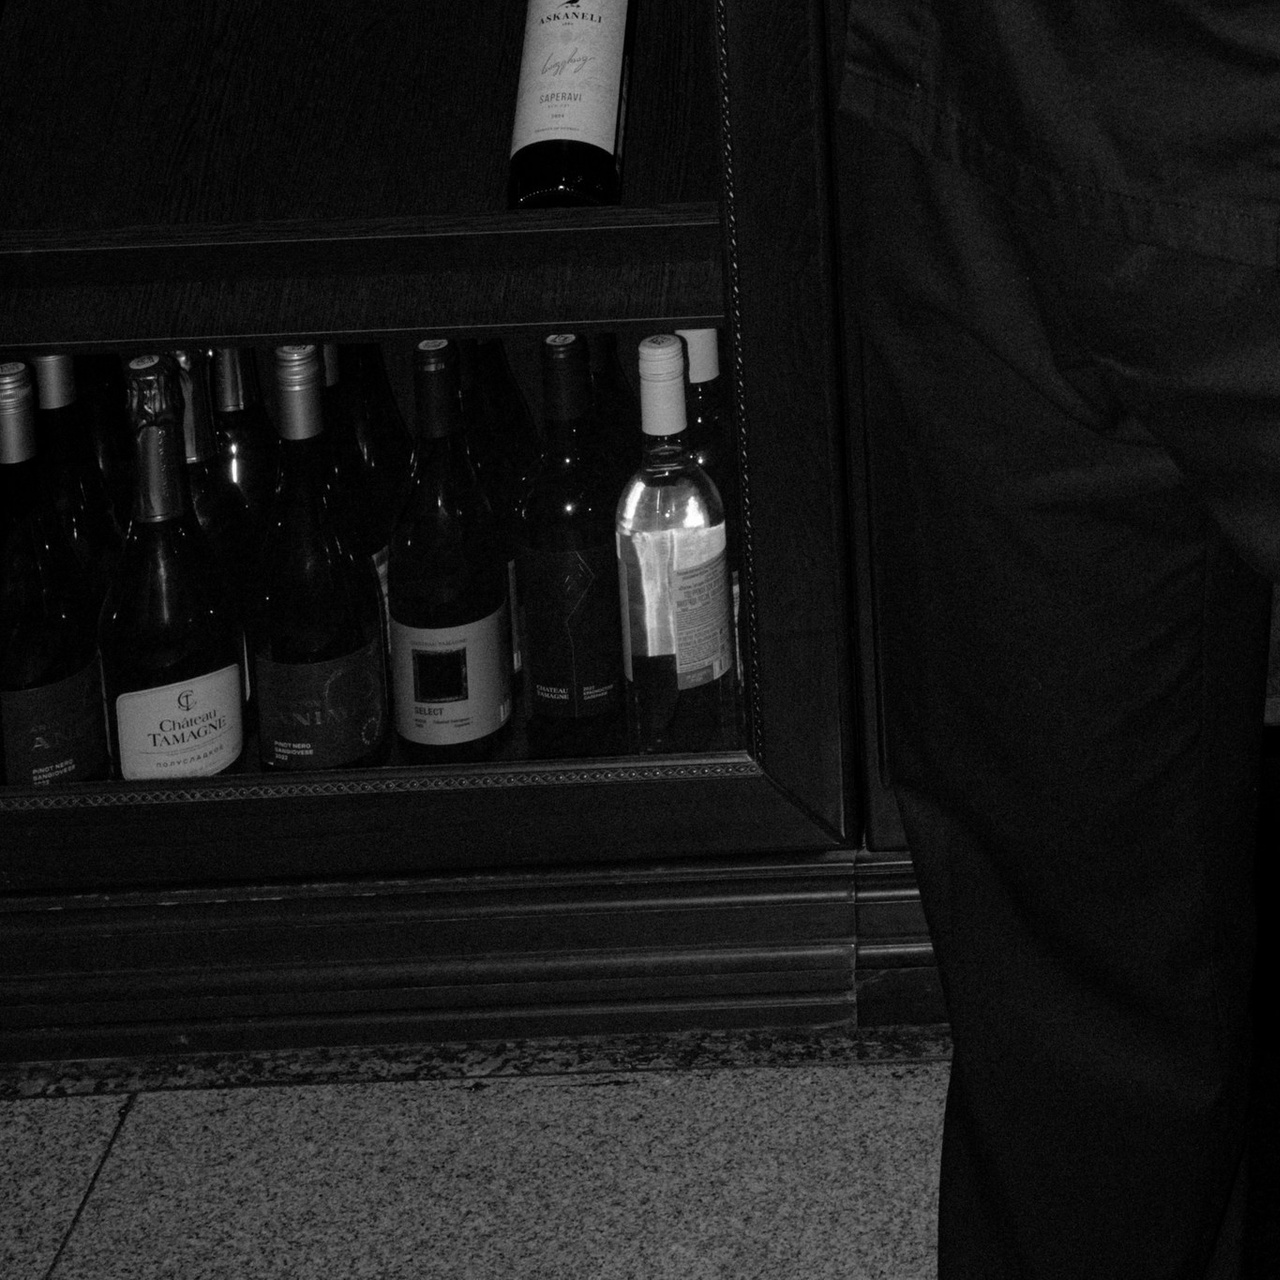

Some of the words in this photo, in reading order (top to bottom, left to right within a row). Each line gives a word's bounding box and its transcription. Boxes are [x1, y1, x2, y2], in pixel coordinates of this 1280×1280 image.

[539, 11, 602, 25] ASKANELI
[539, 92, 582, 104] SAPERAVI
[414, 706, 444, 717] SELECT
[160, 709, 217, 732] Château
[147, 715, 227, 747] TAMAGNE
